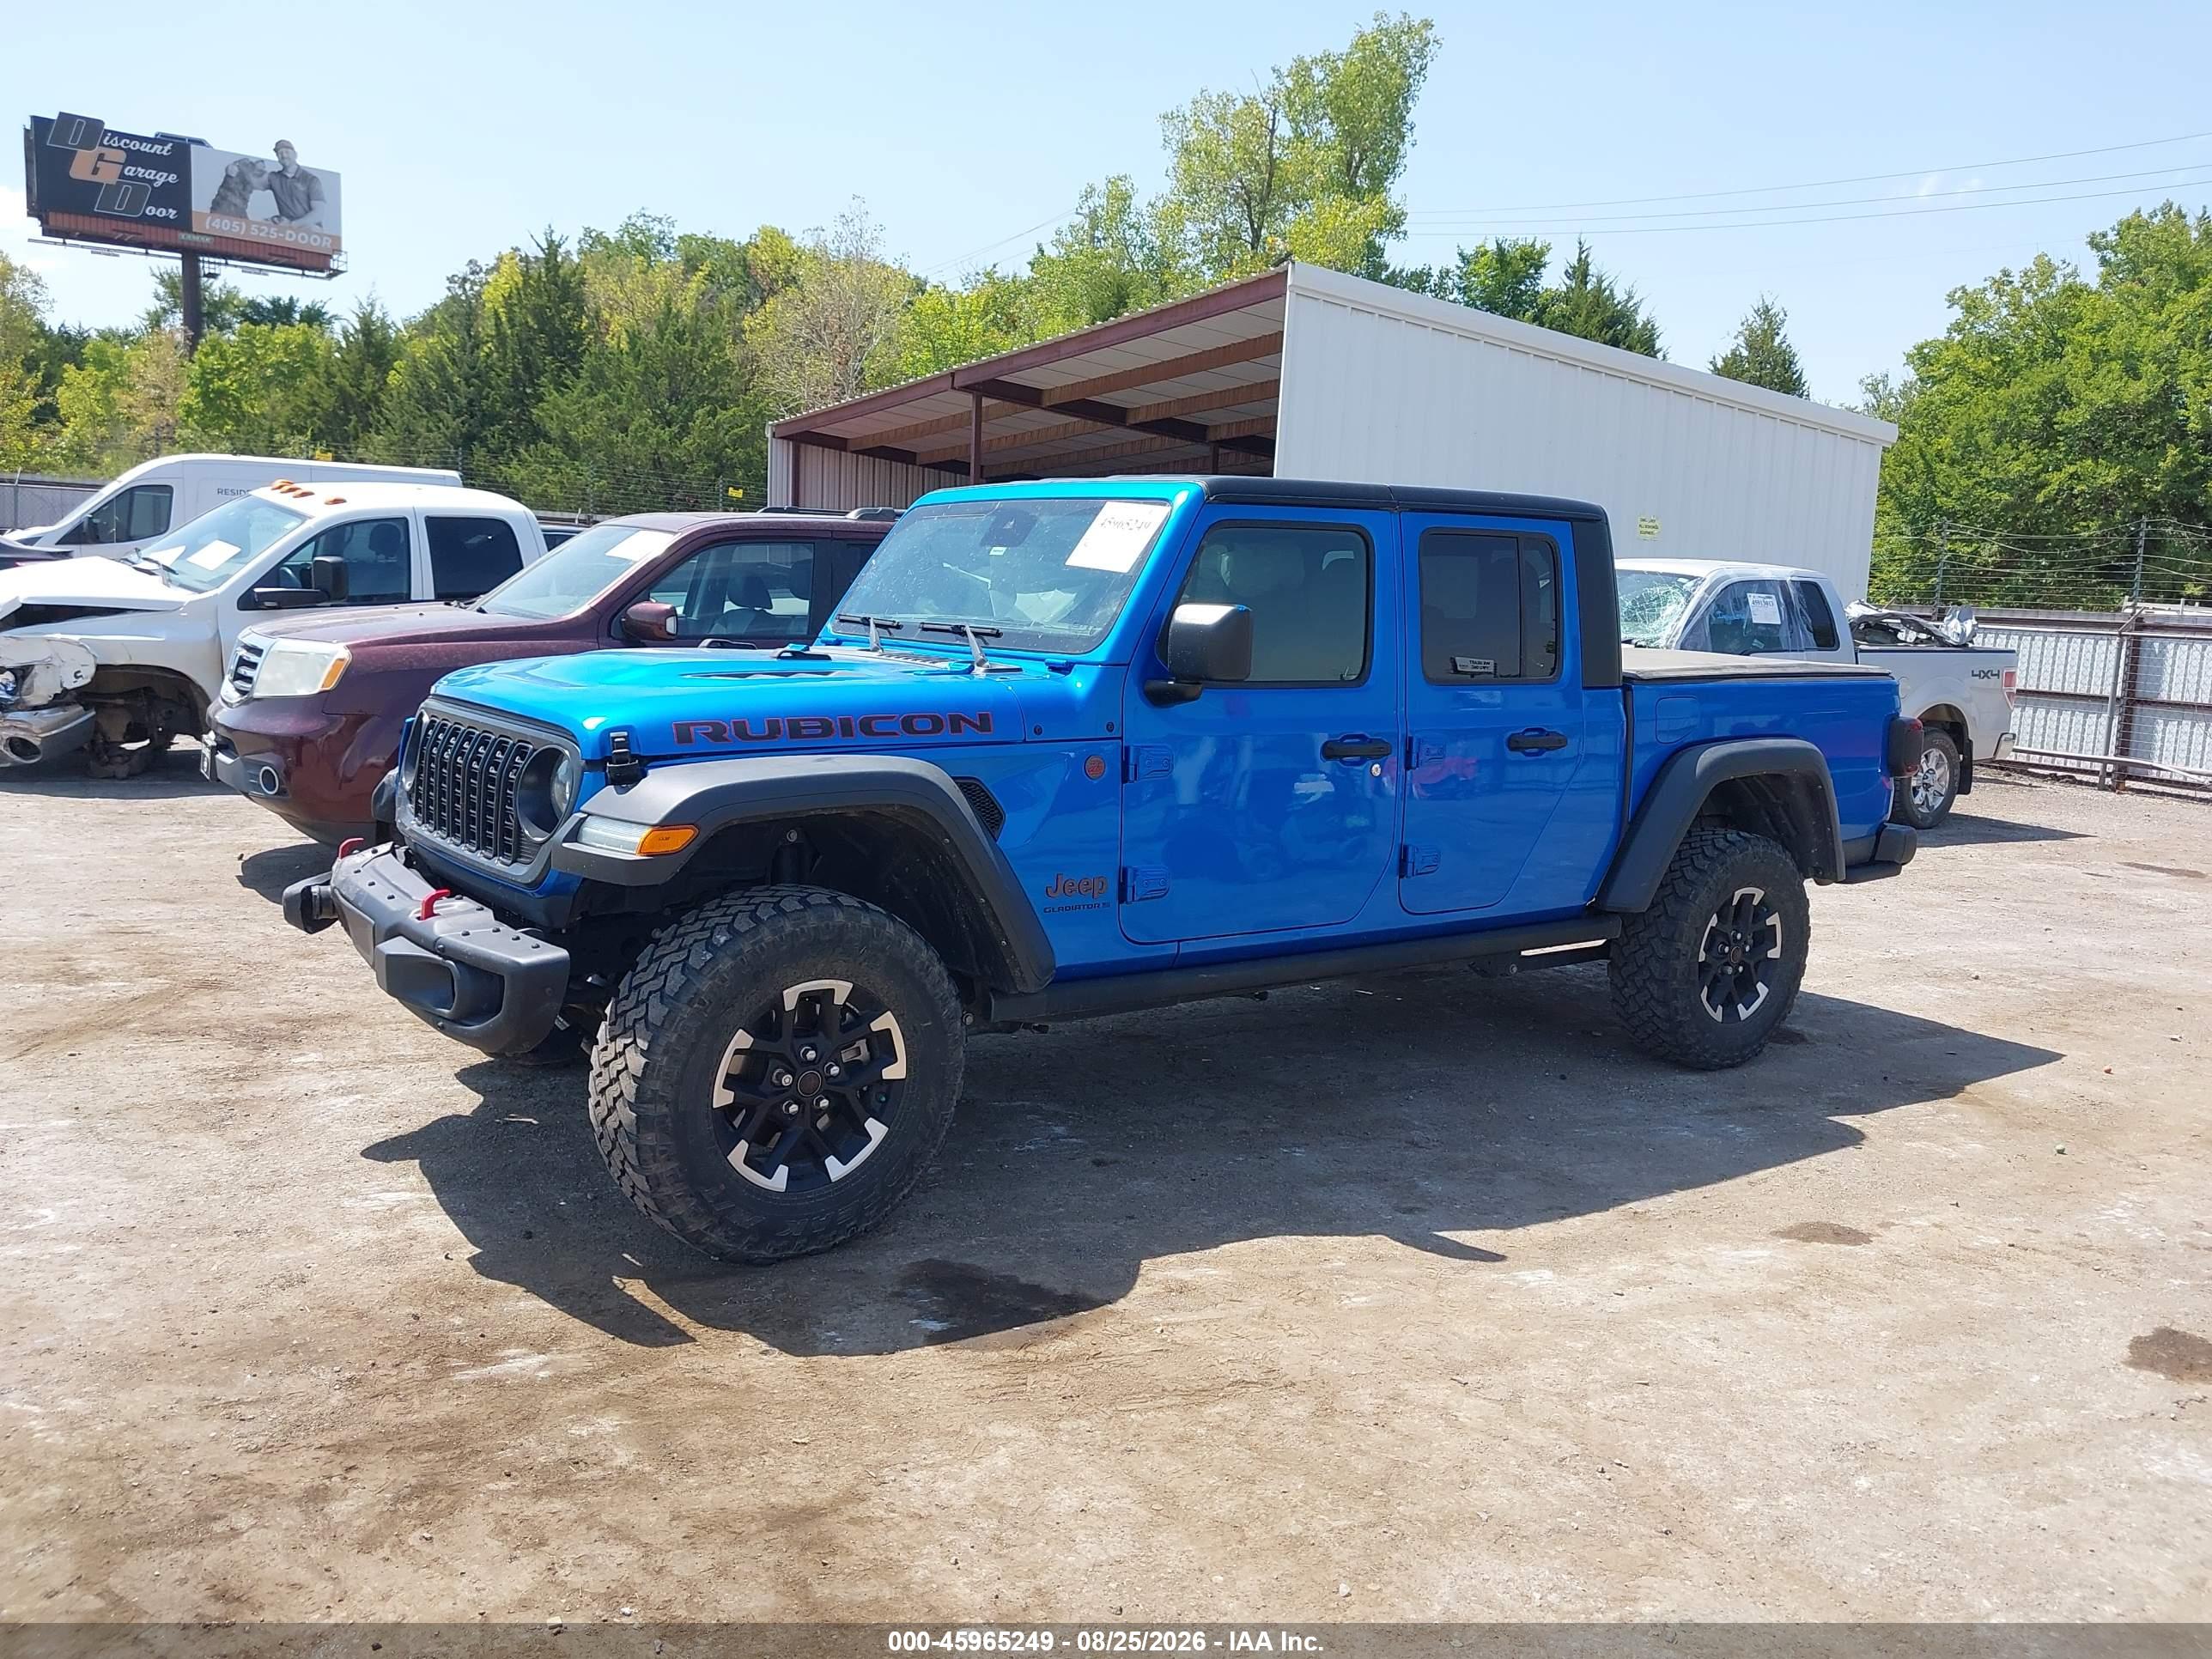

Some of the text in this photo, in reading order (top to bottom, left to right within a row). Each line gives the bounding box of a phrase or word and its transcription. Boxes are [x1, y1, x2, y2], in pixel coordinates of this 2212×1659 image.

[47, 112, 173, 155] Discount
[70, 146, 179, 187] Garage
[94, 178, 179, 217] Door
[205, 216, 331, 248] (405) 525-DOOR
[1971, 670, 2000, 679] 4X4
[673, 712, 994, 744] RUBICON
[1046, 873, 1108, 899] Jeep
[1043, 903, 1100, 914] GLADIATOR
